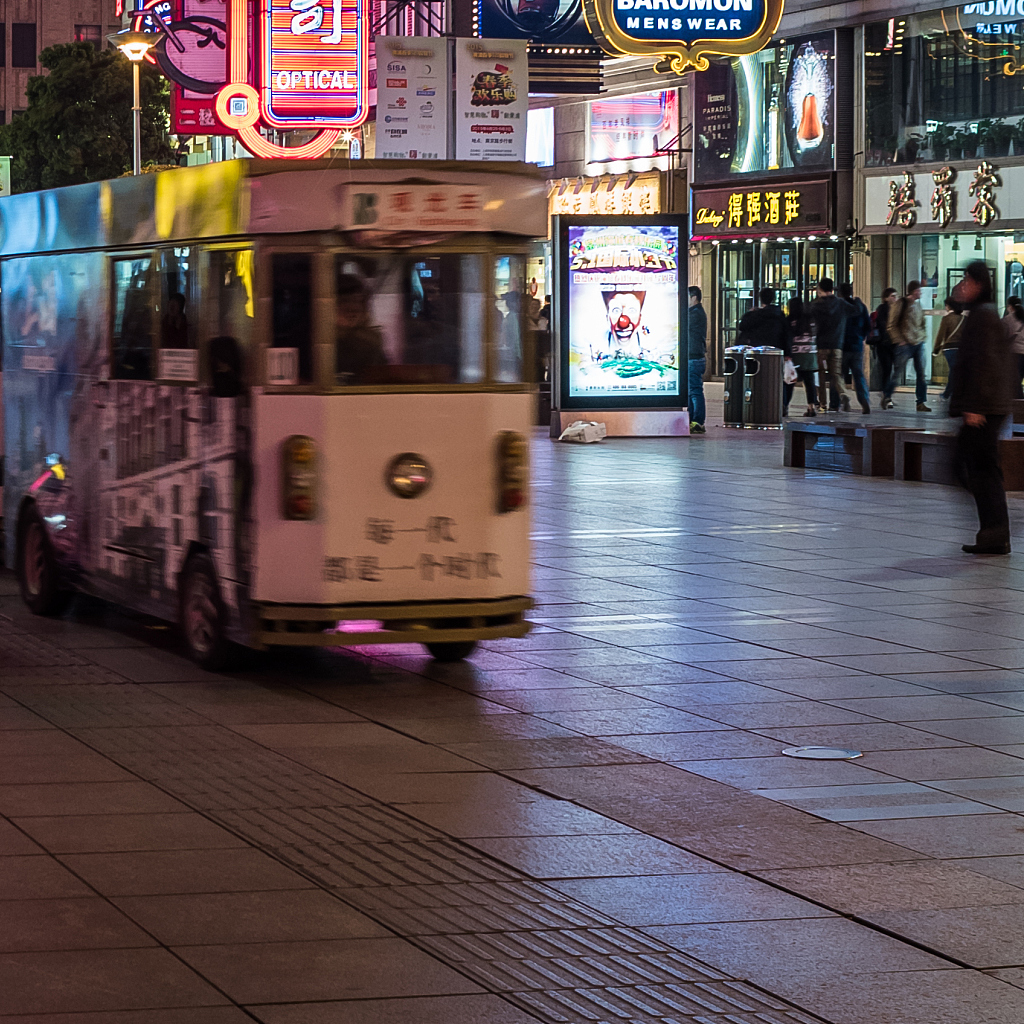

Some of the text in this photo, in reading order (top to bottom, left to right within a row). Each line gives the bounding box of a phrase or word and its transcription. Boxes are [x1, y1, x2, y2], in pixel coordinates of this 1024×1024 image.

[627, 16, 743, 32] MENS WEAR
[387, 63, 406, 72] SISA
[276, 70, 355, 90] OPTICAL
[702, 106, 732, 114] PARADIS
